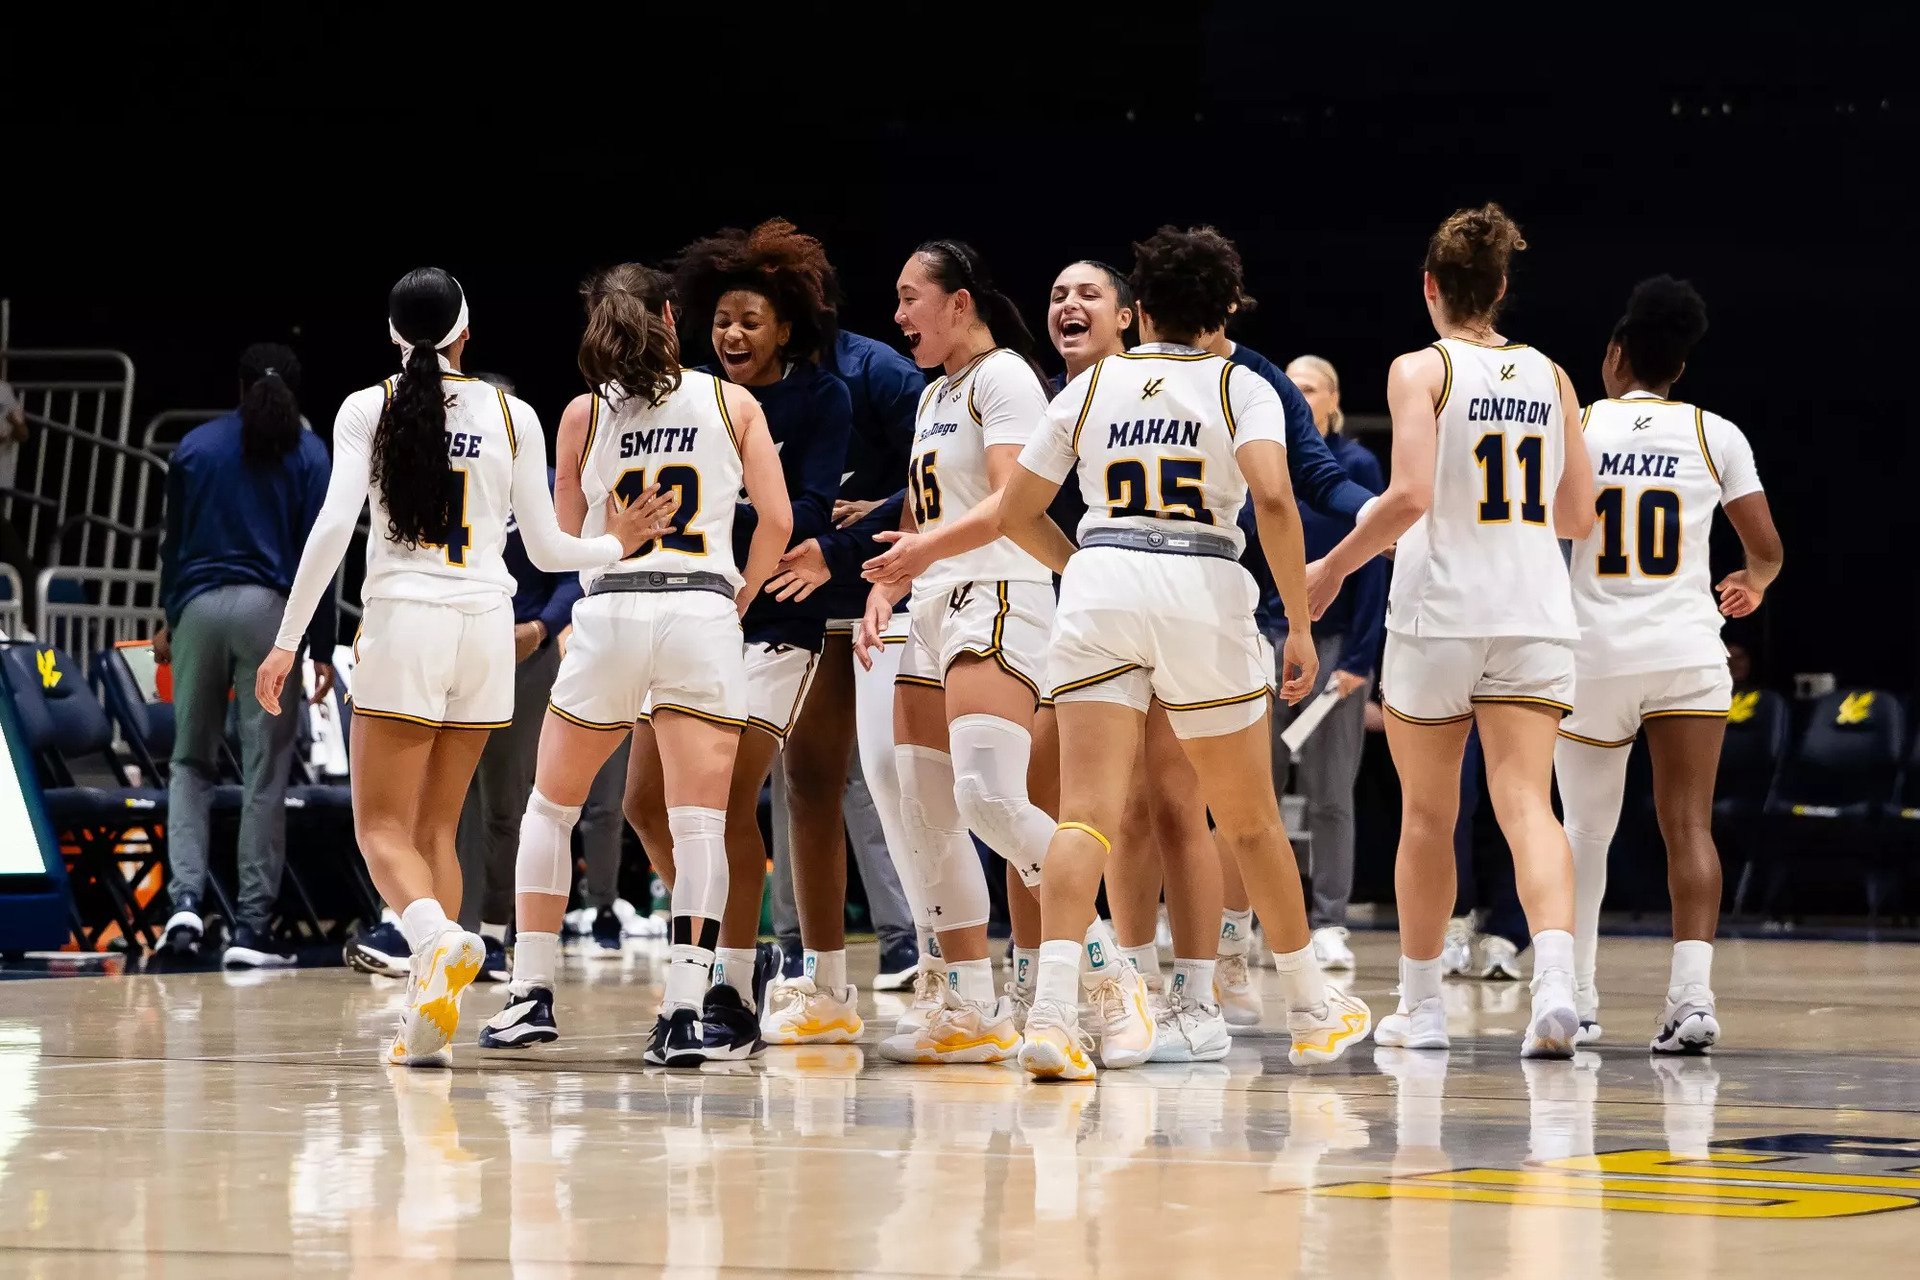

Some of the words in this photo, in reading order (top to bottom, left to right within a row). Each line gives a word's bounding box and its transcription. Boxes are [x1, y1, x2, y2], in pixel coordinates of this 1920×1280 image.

[1468, 397, 1552, 426] CONDRON
[619, 427, 698, 459] SMITH
[932, 422, 958, 437] Diego
[1107, 418, 1201, 449] MAHAN
[1472, 431, 1547, 526] 11
[1598, 452, 1679, 478] MAXIE
[1104, 455, 1217, 526] 25
[1594, 484, 1684, 580] 10
